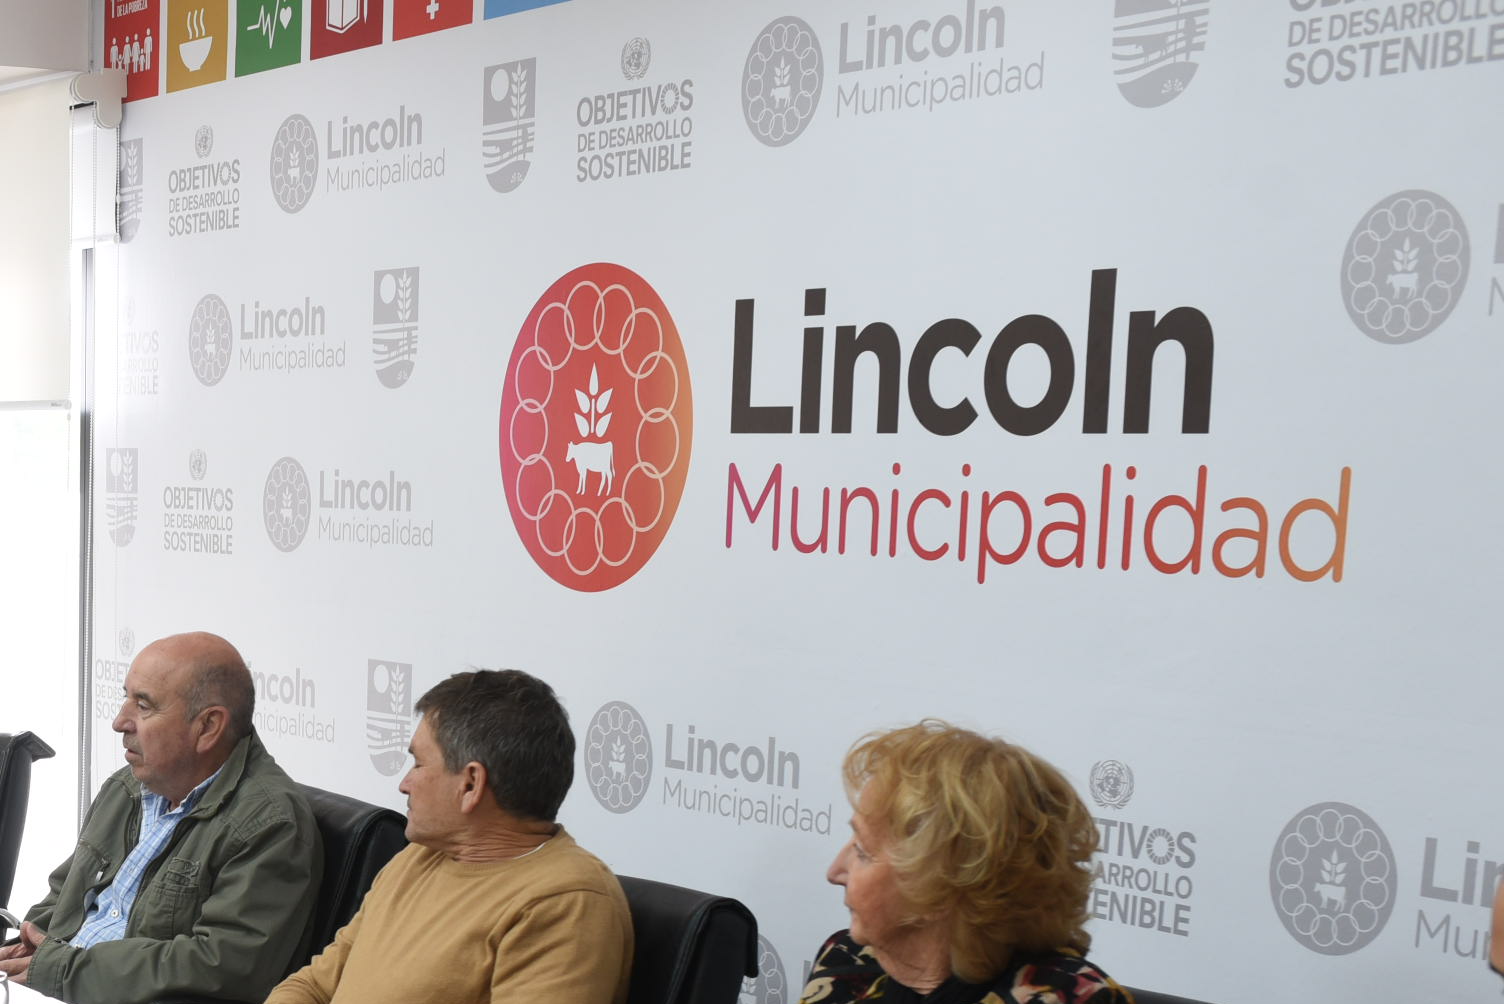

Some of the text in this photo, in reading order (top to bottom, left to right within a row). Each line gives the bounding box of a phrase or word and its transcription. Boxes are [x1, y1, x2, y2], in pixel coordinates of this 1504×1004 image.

[838, 0, 1006, 74] Lincoln
[1288, 17, 1323, 47] DE
[1284, 23, 1504, 89] SOSTENIBLE
[576, 79, 694, 127] OBJETIVOS
[836, 51, 1045, 118] Municipalidad
[327, 104, 423, 160] Lincoln
[577, 116, 693, 153] DE DESARROLLO
[168, 159, 240, 194] OBJETIVOS
[326, 148, 445, 193] Municipalidad
[576, 141, 692, 182] SOSTENIBLE
[168, 207, 240, 237] SOSTENIBLE
[169, 188, 240, 213] DE DESARROLLO
[240, 296, 325, 340] Lincoln
[240, 340, 346, 374] Municipalidad
[730, 268, 1214, 437] Lincoln
[163, 486, 234, 512] OBJETIVOS
[319, 469, 412, 512] Lincoln
[163, 530, 233, 555] SOSTENIBLE
[164, 512, 233, 531] DE DESARROLLO
[318, 516, 434, 549] Municipalidad
[725, 462, 1352, 585] Municipalidad
[665, 723, 800, 789] Lincoln
[663, 776, 832, 836] Municipalidad
